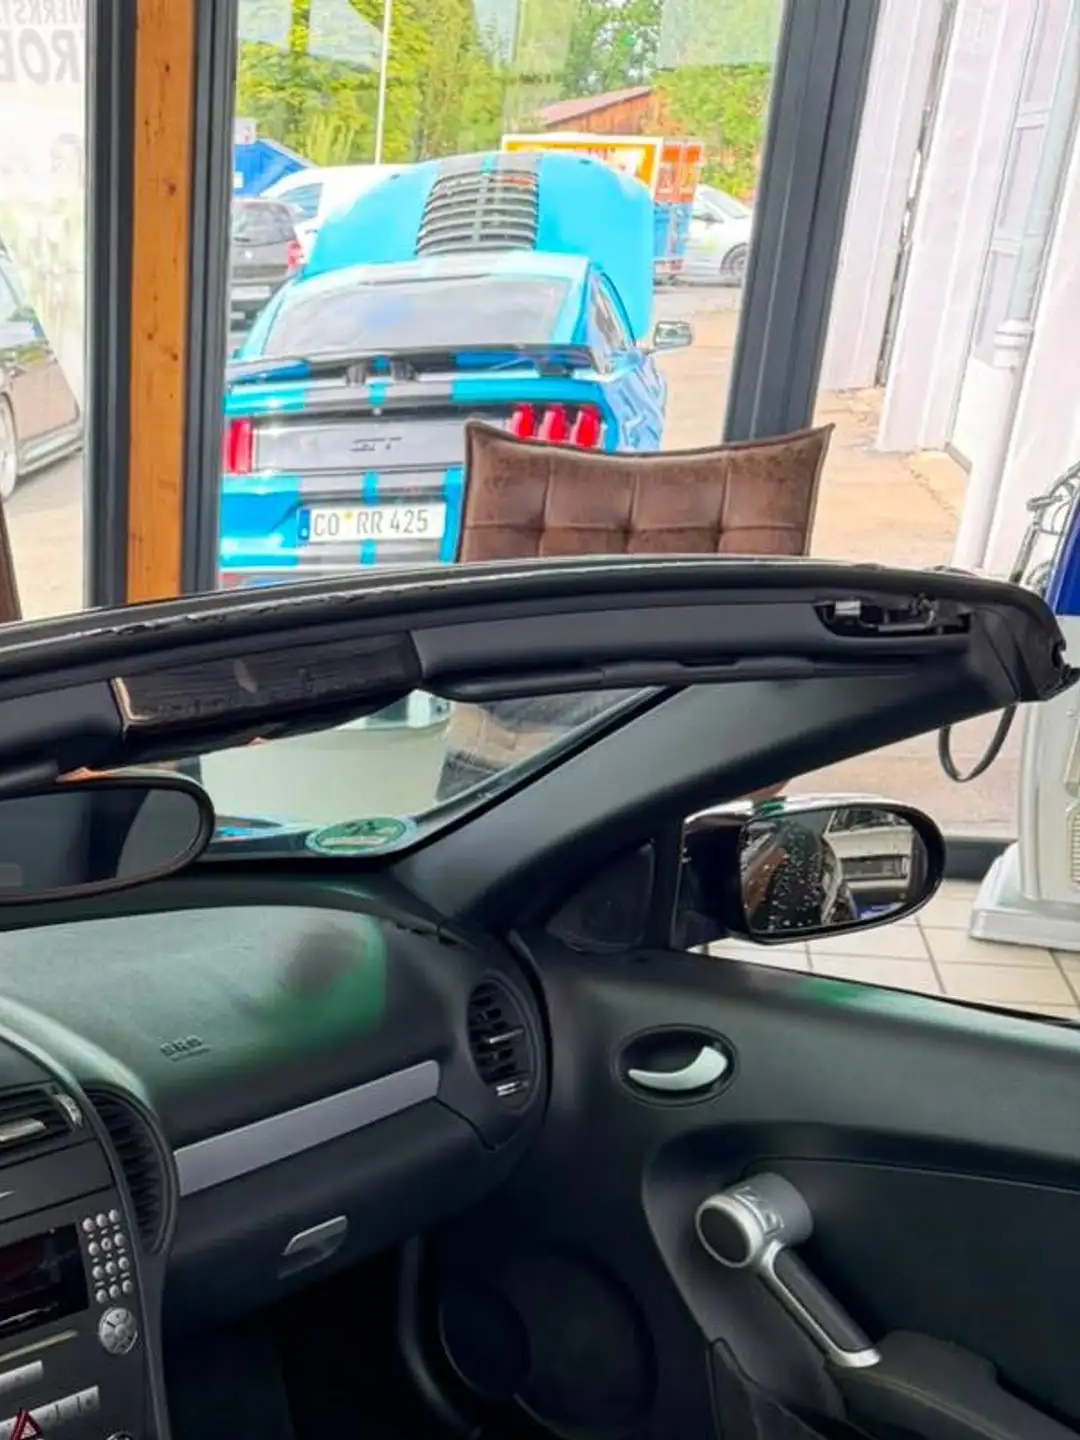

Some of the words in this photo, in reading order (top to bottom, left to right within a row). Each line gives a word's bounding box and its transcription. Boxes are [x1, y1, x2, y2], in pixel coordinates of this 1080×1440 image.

[314, 512, 340, 537] CO
[356, 510, 383, 534] RR
[389, 508, 429, 534] 425
